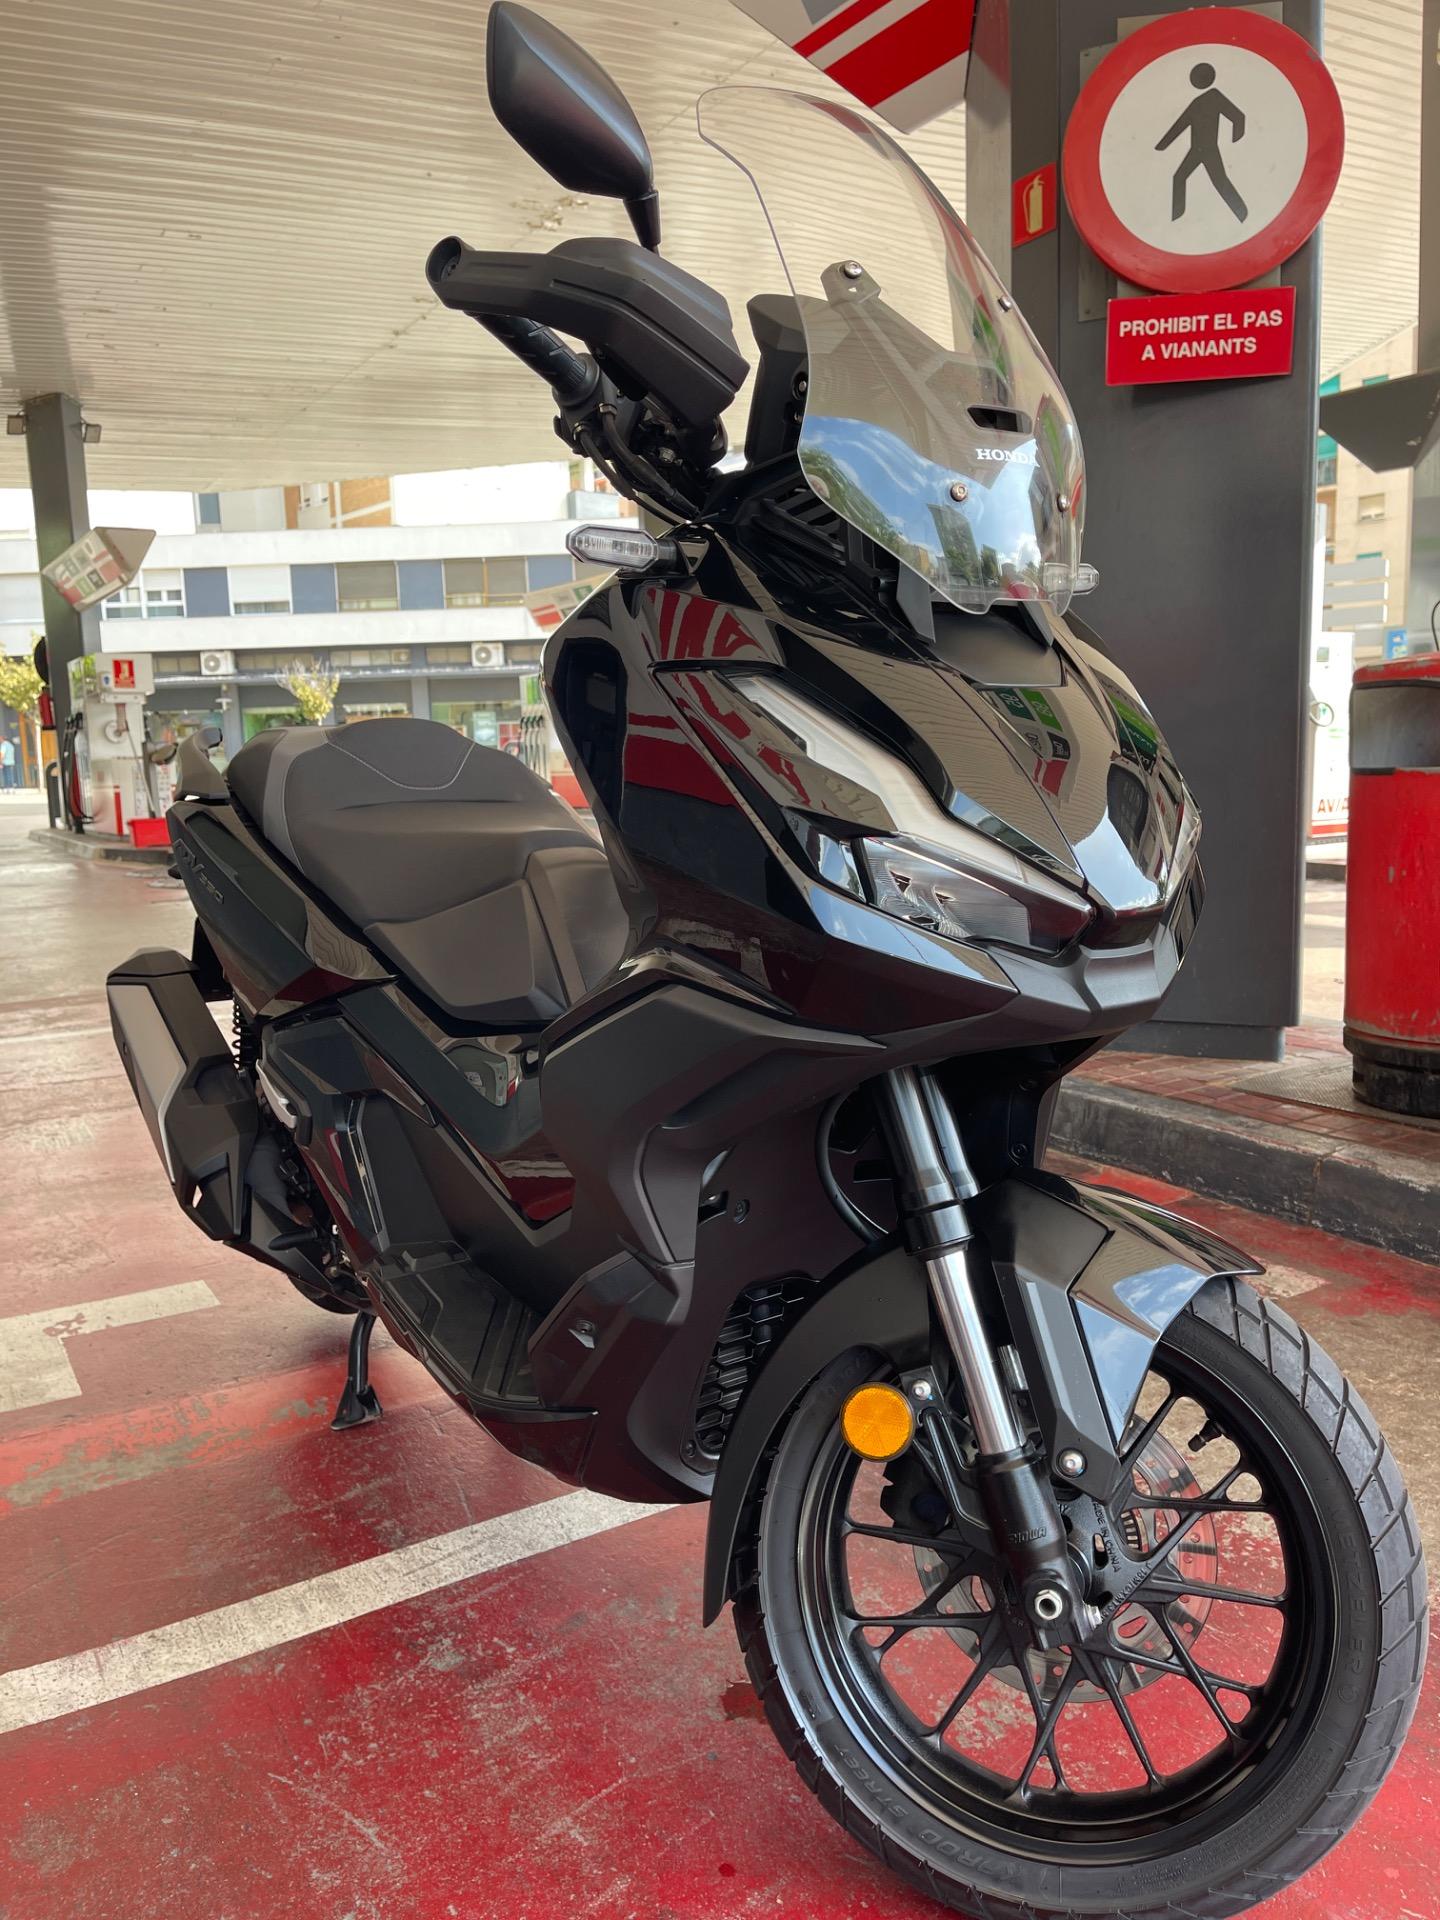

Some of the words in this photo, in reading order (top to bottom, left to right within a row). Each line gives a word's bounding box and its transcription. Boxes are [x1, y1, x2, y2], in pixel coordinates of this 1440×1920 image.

[1118, 314, 1209, 338] PROHIBIT
[1213, 312, 1238, 330] EL
[1242, 309, 1283, 328] PAS
[1141, 344, 1156, 361] A
[1160, 336, 1257, 360] VIANANTS
